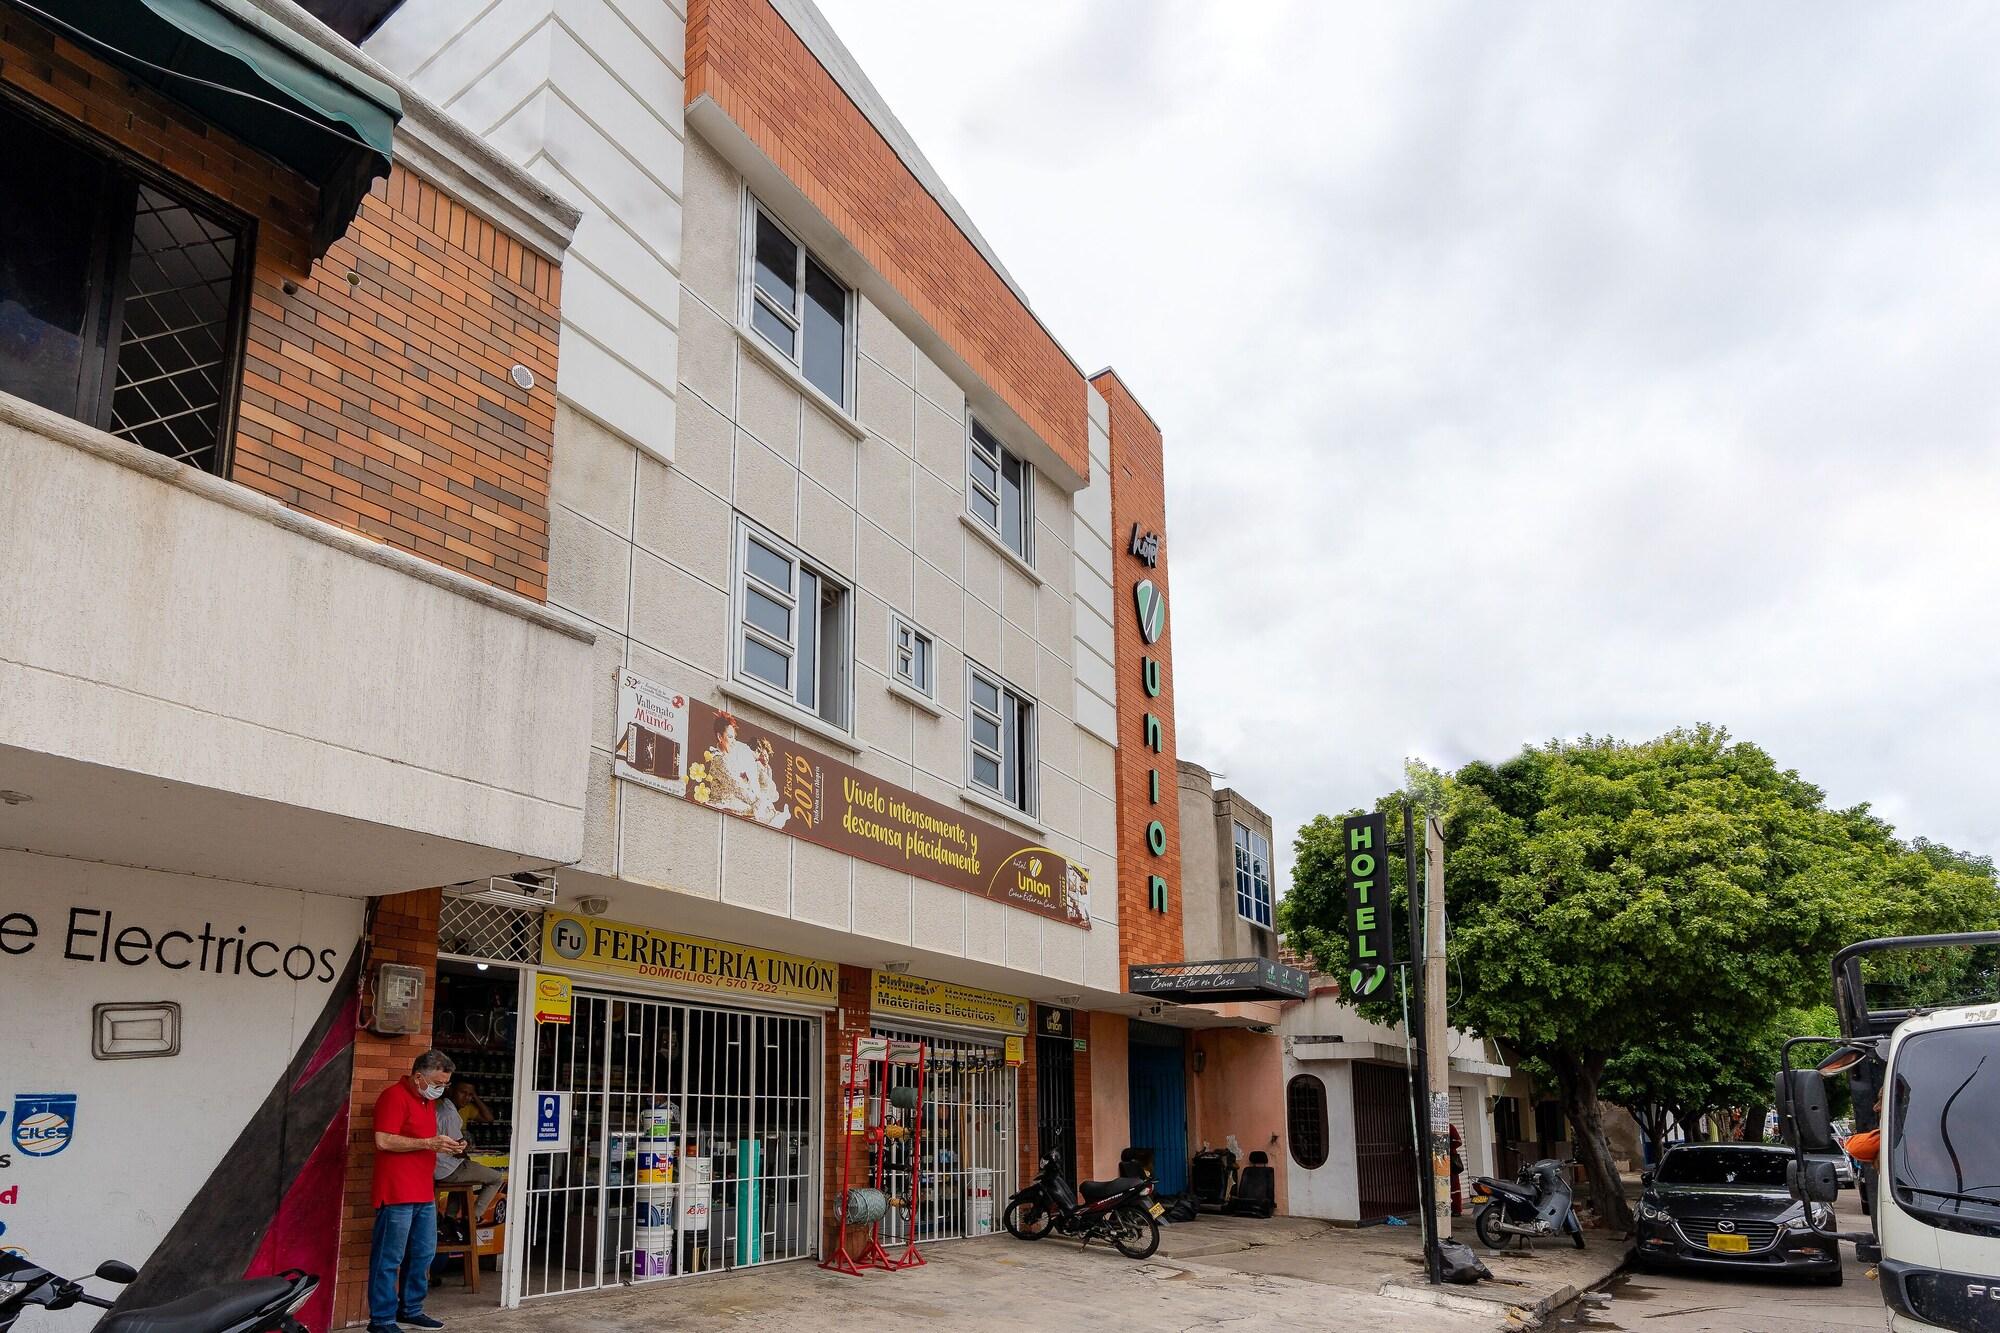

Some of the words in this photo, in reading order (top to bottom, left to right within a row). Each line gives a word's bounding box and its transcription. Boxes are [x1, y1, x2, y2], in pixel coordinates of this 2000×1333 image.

[634, 707, 674, 733] Mundo
[635, 692, 674, 719] Vallenato
[783, 752, 794, 799] Festival
[794, 755, 813, 830] 2019
[843, 776, 885, 814] Vívelo
[889, 797, 968, 850] intensamente,
[971, 832, 978, 856] y
[843, 805, 902, 850] descansa
[906, 830, 981, 876] plácidamente
[1351, 826, 1377, 958] HOTEL
[63, 907, 337, 983] Electricos
[556, 927, 581, 951] Fu
[639, 964, 713, 985] DOMICILIOS
[726, 977, 748, 990] 570
[751, 980, 778, 994] 7222
[767, 960, 834, 993] UNIÓN
[1175, 976, 1200, 989] Estar
[1212, 974, 1236, 987] Casa
[877, 991, 942, 1014] Materiales
[17, 1126, 71, 1140] CILES
